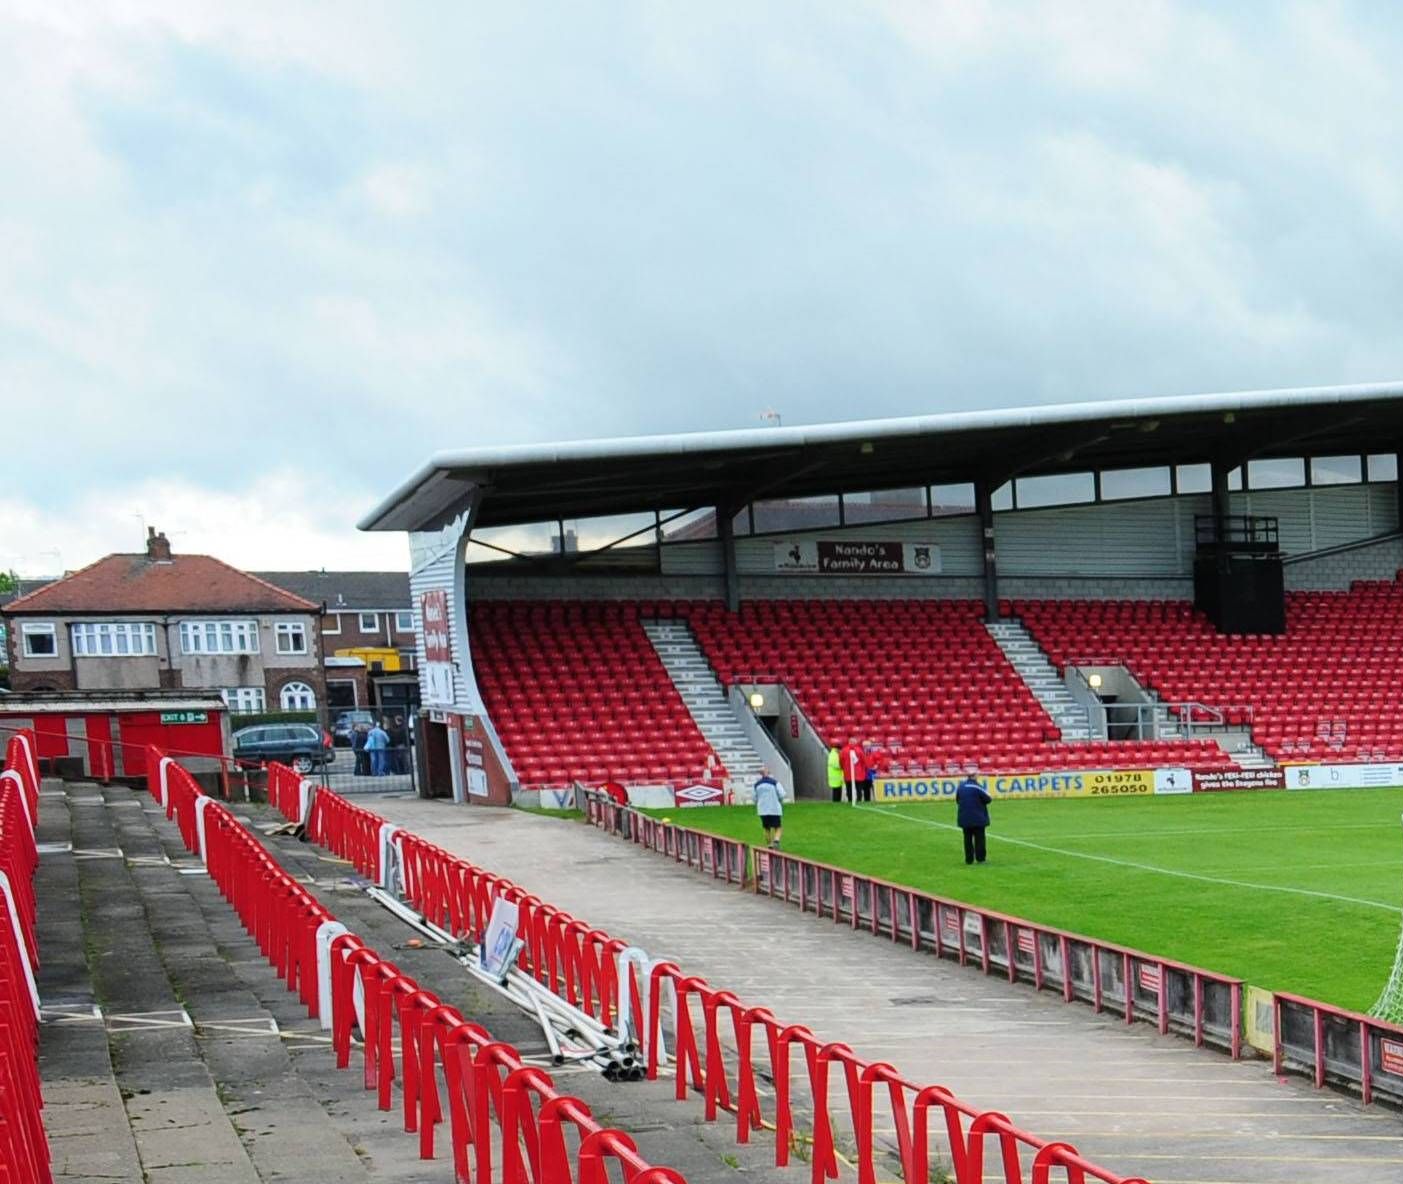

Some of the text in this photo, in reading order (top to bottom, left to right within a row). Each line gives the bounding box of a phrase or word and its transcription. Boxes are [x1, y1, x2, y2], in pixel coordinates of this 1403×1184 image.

[823, 557, 866, 572] Family
[869, 558, 899, 569] Area
[996, 774, 1083, 793] CARPETS
[1094, 774, 1142, 784] 01978
[1091, 784, 1148, 794] 265050
